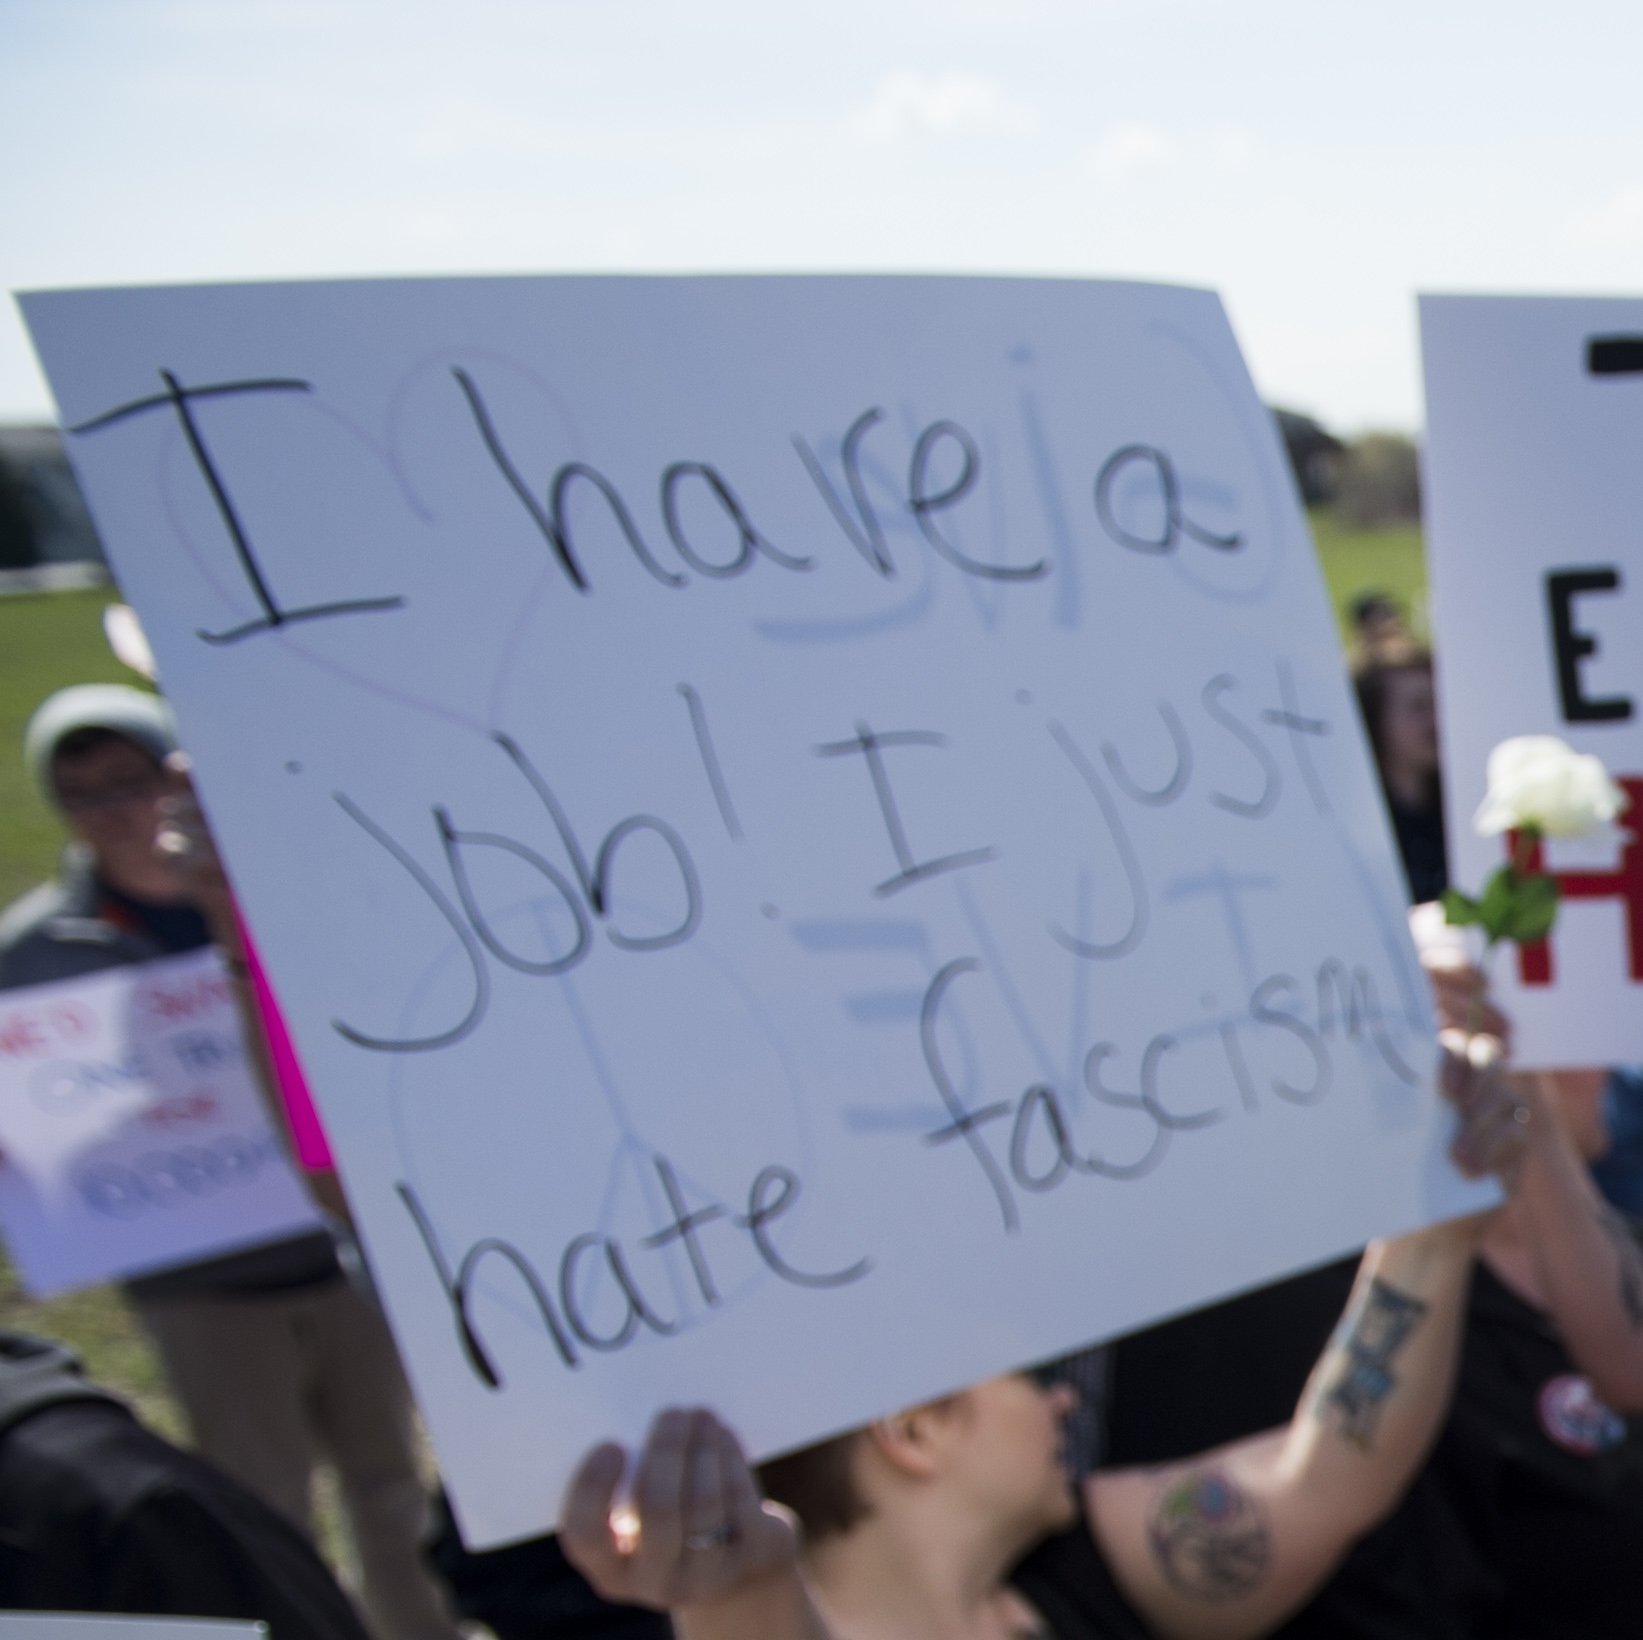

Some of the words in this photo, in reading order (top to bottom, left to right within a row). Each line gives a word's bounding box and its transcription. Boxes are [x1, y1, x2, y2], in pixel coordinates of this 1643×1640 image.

[66, 364, 407, 647] I
[1094, 440, 1246, 556] a
[812, 716, 1000, 900] I
[1013, 657, 1334, 962] just
[393, 1150, 875, 1390] hate
[921, 954, 1422, 1237] fascism
